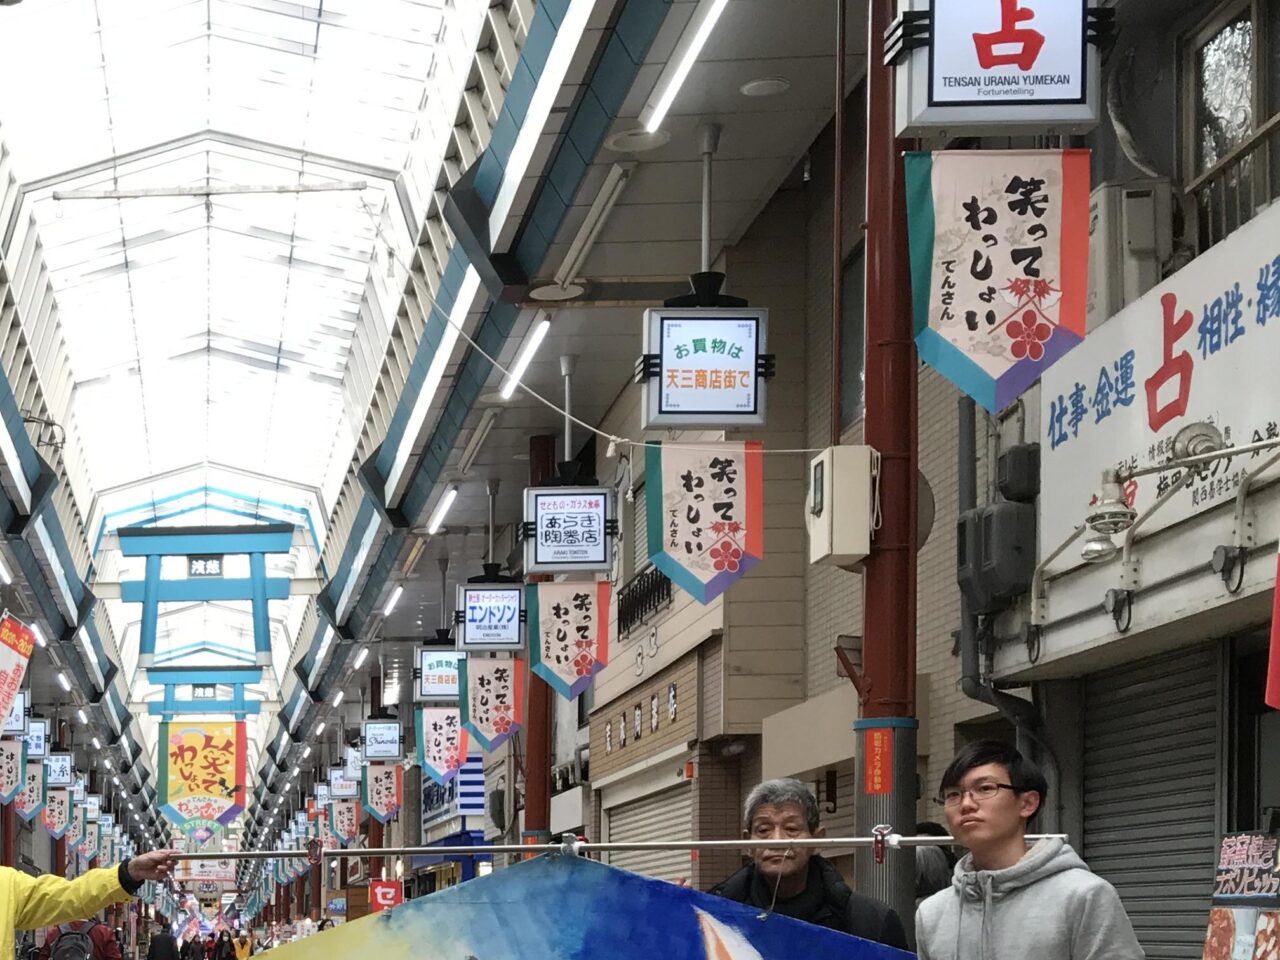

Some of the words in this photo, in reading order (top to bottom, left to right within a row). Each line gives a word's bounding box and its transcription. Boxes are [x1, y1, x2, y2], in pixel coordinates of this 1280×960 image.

[972, 0, 1045, 71] 占
[942, 76, 981, 87] TENSAN
[984, 75, 1020, 86] URANAI
[1022, 74, 1070, 85] YUMEKAN
[977, 88, 1035, 96] Fortunetelling
[1005, 175, 1049, 278] 笑って
[962, 196, 998, 331] わっしょい
[940, 259, 957, 322] てんさん
[674, 338, 744, 359] お買物は
[1145, 293, 1194, 433] 占
[666, 368, 750, 389] 天三商店街で
[1048, 349, 1136, 451] 仕事・金運
[681, 470, 705, 554] わっしょい
[709, 457, 738, 521] 笑って
[545, 515, 596, 530] あらき
[545, 529, 597, 544] 陶器店
[669, 509, 679, 548] てんさん
[468, 605, 516, 623] エンドソン
[552, 603, 569, 664] わっしょい
[573, 593, 592, 639] 笑って
[478, 675, 492, 724] わっしょい
[493, 667, 509, 704] 笑って
[169, 744, 201, 792] わっしょい
[200, 734, 235, 794] 笑って
